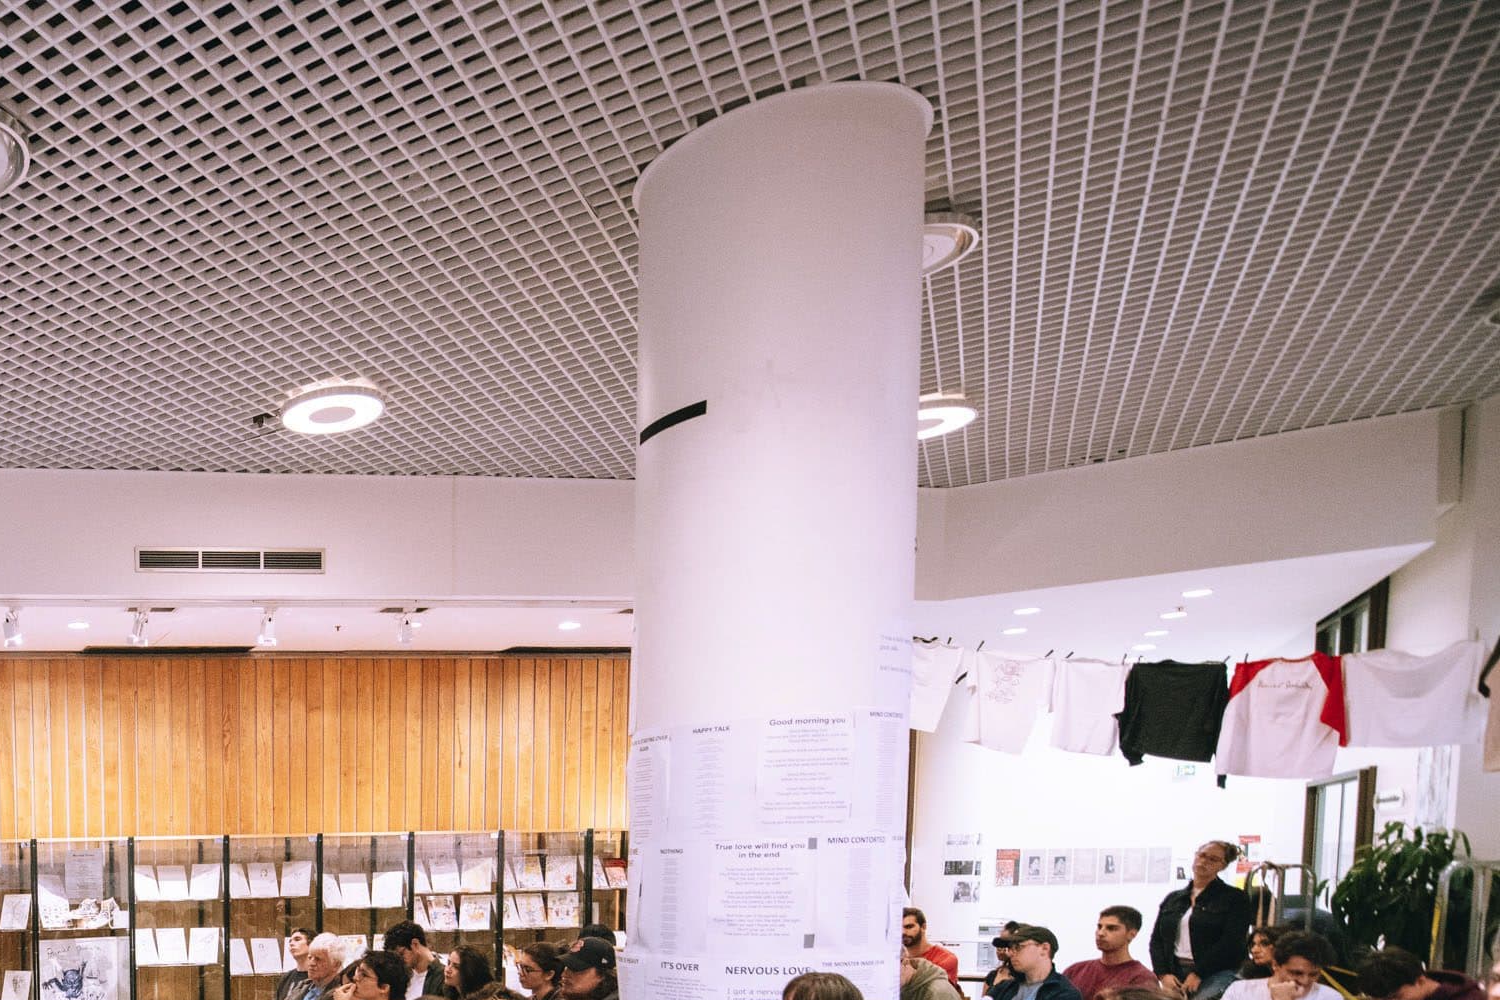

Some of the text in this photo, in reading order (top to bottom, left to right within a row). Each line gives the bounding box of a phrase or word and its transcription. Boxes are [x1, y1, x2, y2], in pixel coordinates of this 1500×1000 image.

[769, 717, 846, 727] Good morning you
[693, 727, 713, 735] HAPPY
[715, 843, 733, 851] True
[790, 843, 805, 851] you
[749, 851, 761, 859] the
[660, 961, 700, 971] IT'S OVER
[725, 966, 780, 976] NERVOUS
[733, 988, 747, 997] got
